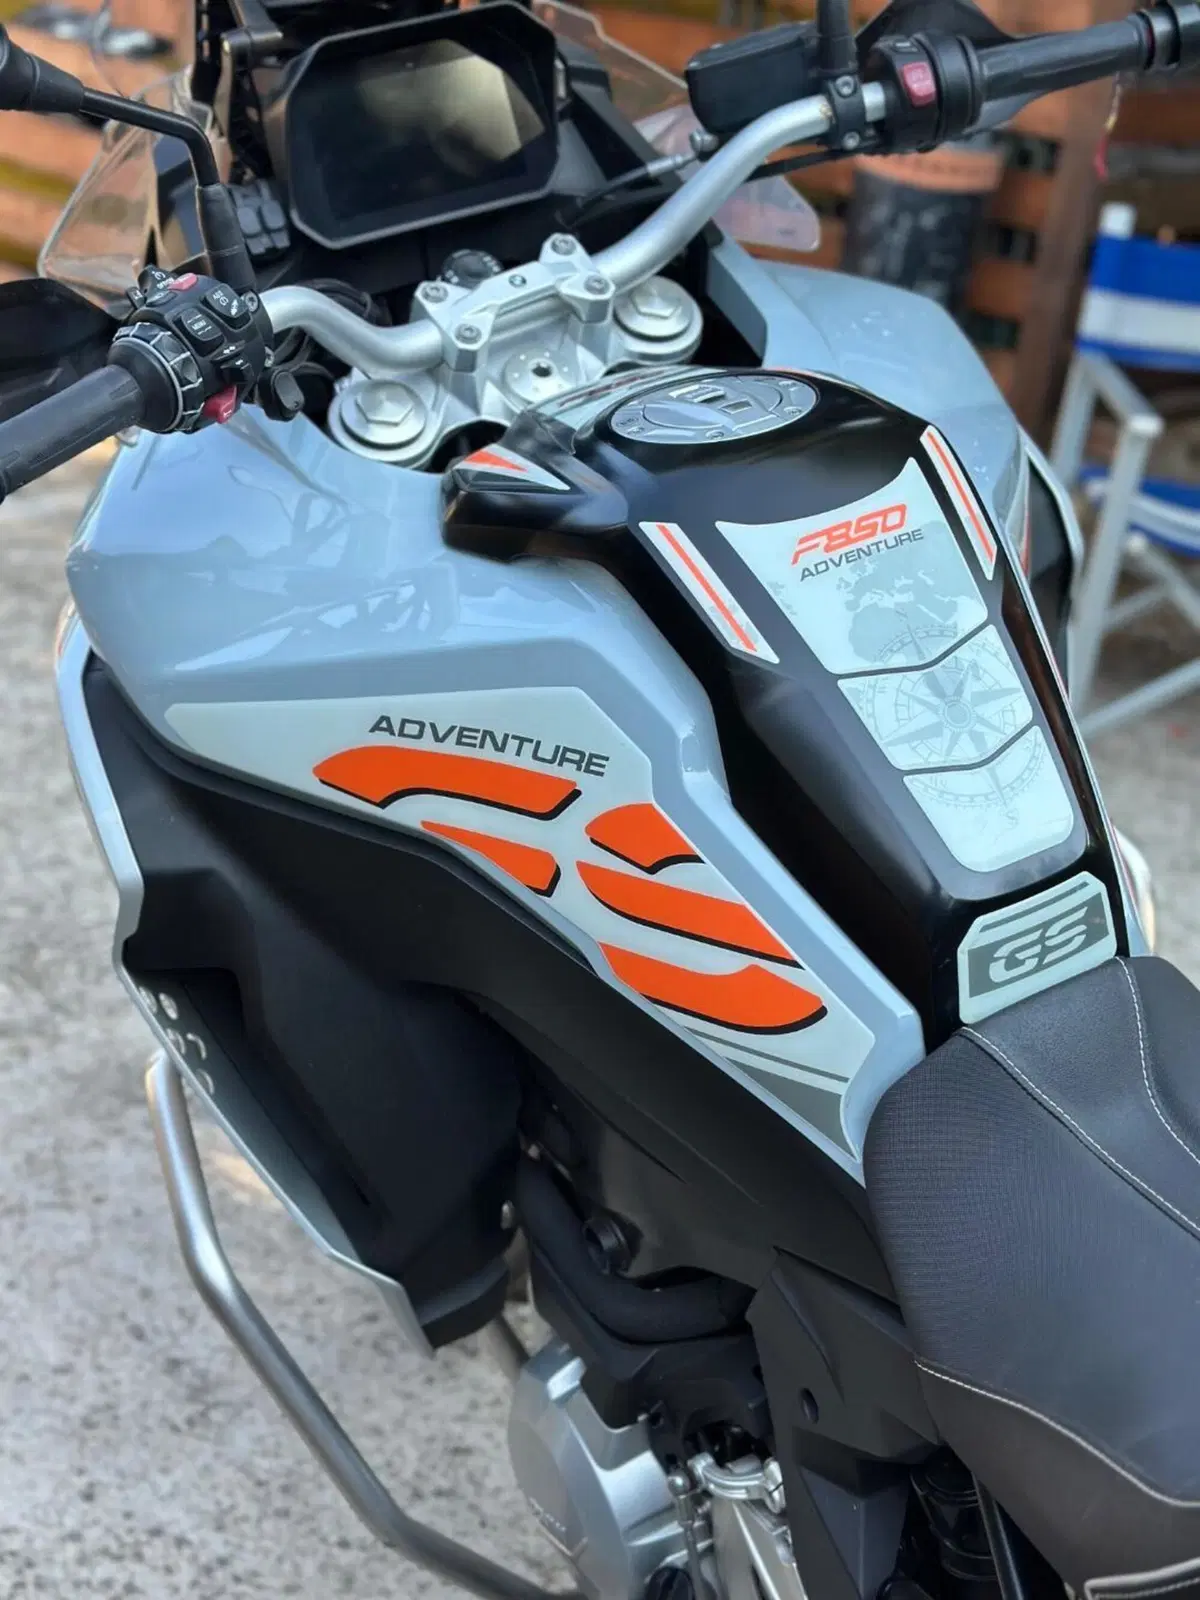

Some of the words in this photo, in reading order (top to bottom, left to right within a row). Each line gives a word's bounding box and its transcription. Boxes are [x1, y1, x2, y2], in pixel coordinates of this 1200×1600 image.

[791, 503, 907, 566] F850
[800, 528, 925, 582] ADVENTURE
[368, 715, 610, 777] ADVENTURE
[989, 906, 1088, 983] GS
